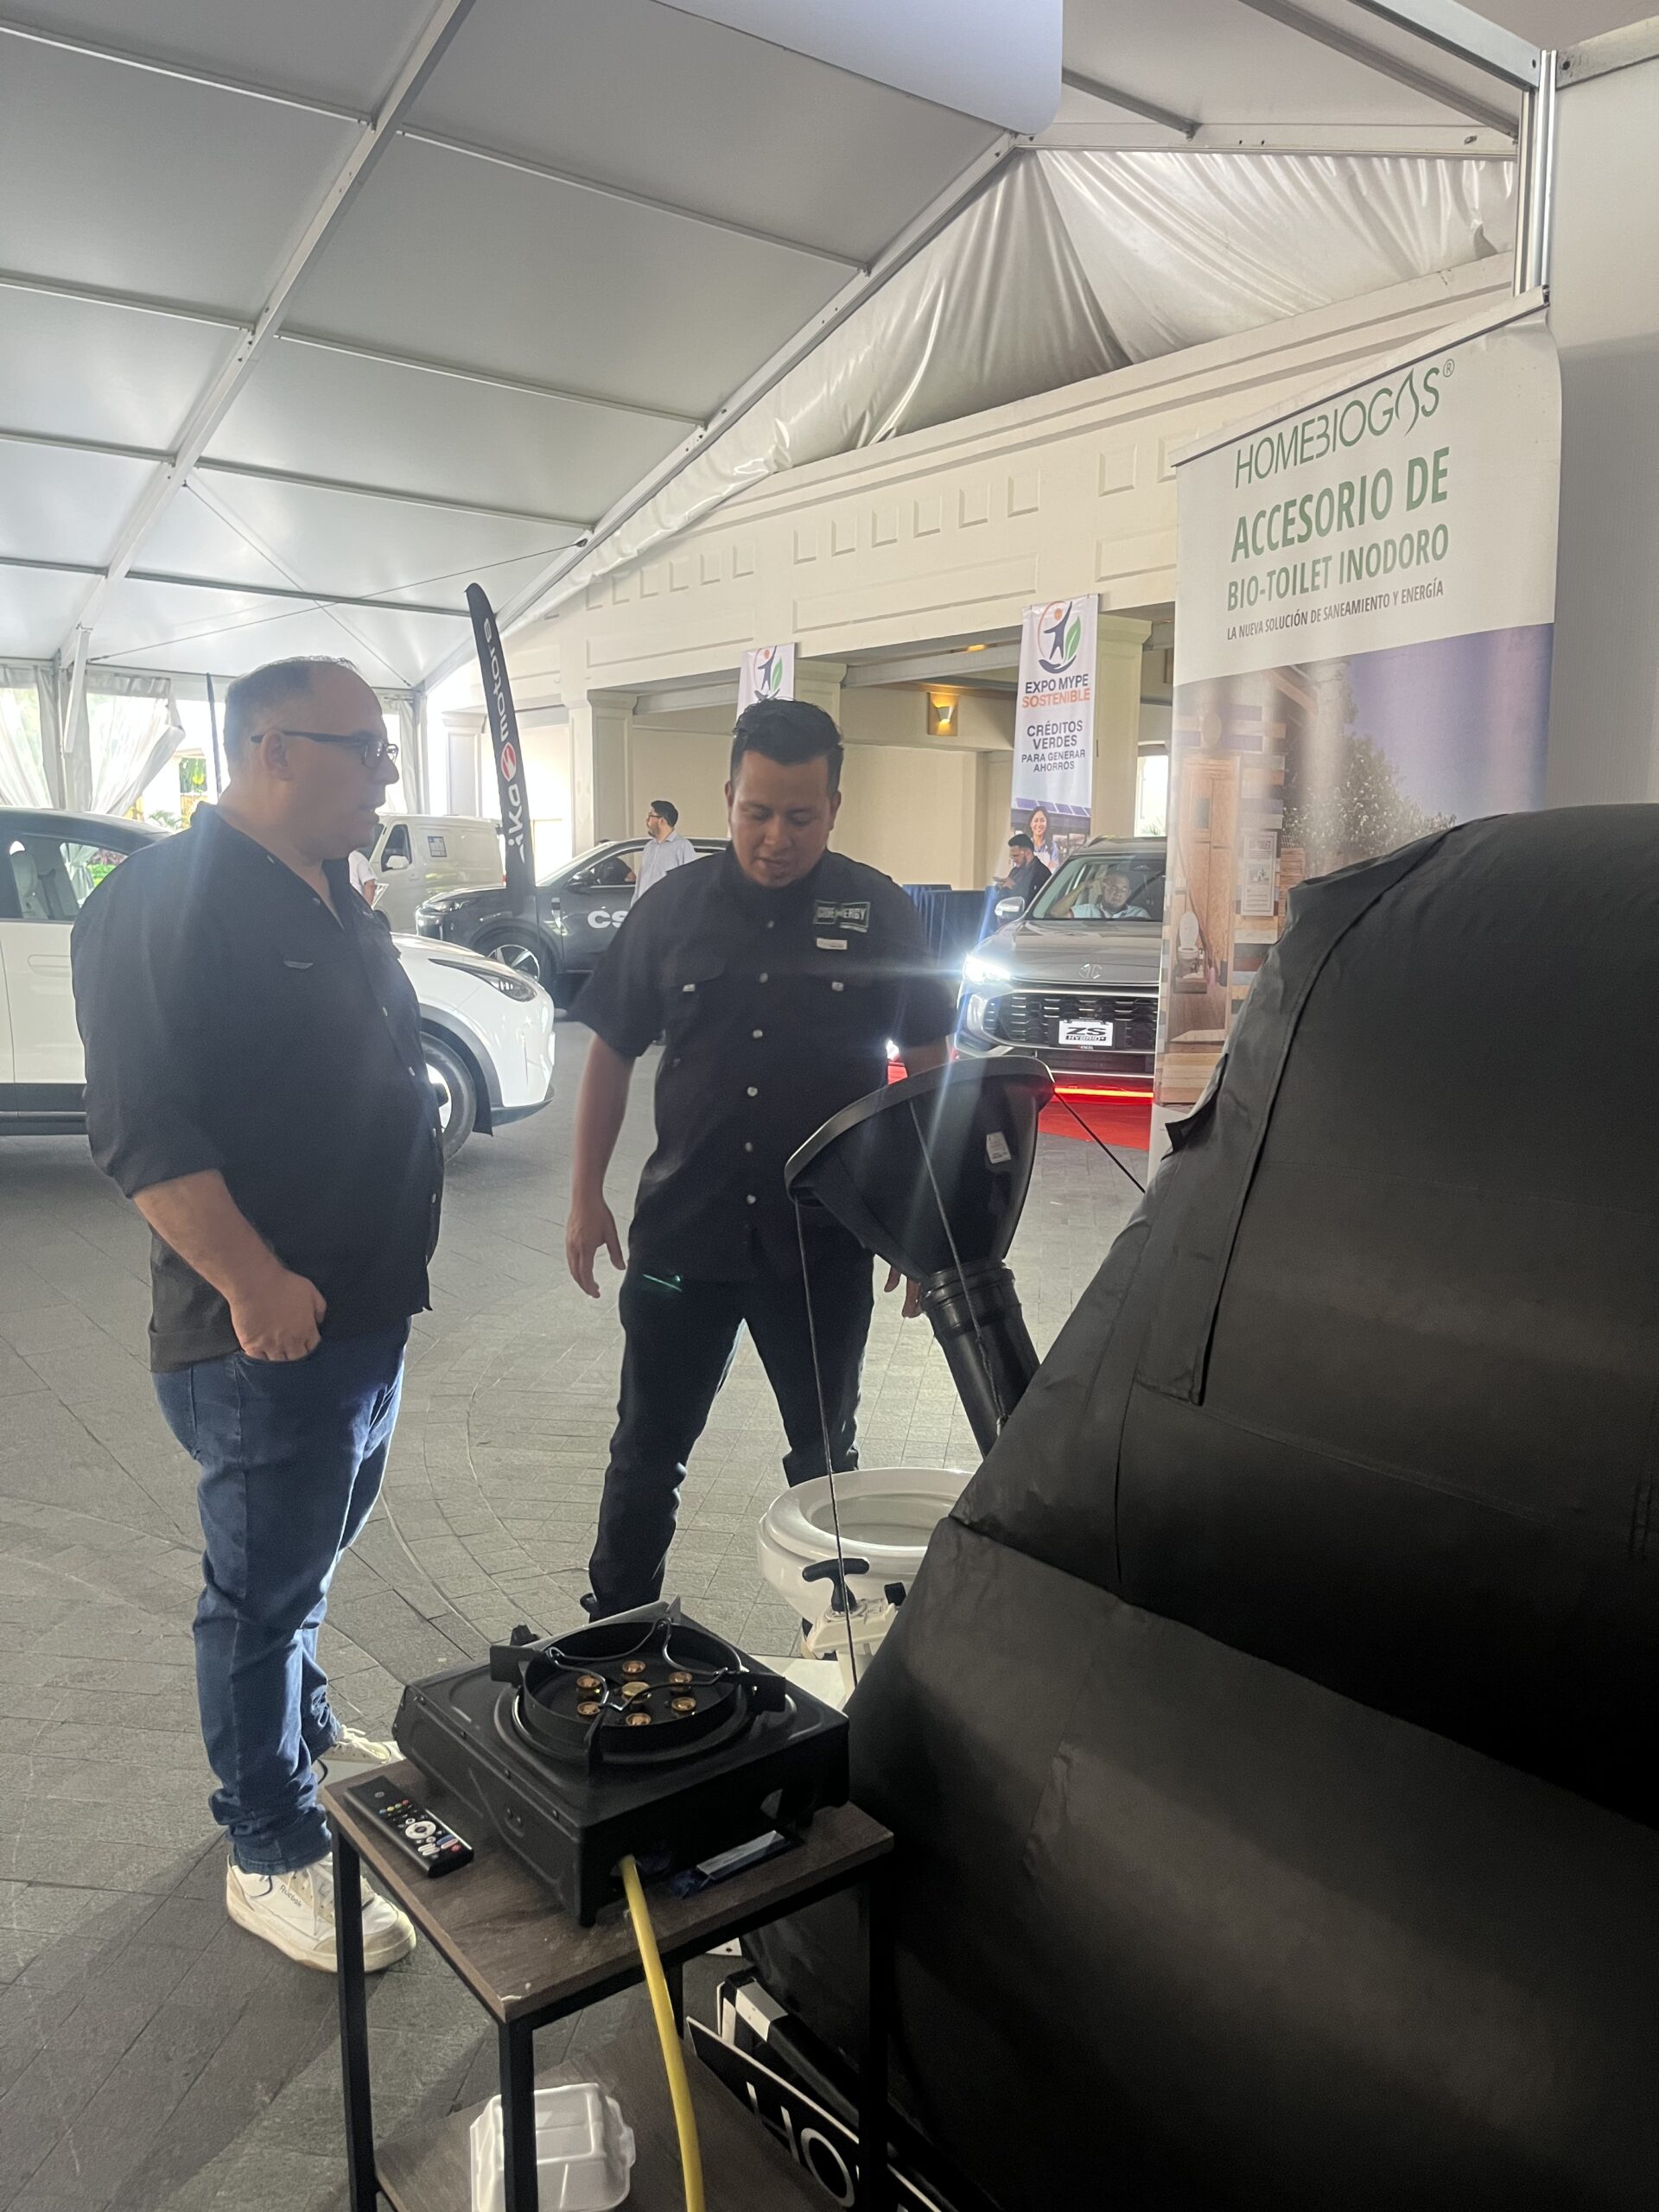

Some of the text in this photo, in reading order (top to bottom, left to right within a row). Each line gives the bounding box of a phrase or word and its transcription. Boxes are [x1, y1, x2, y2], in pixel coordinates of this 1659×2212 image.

[1231, 447, 1450, 563] ACCESORIO DE
[1227, 524, 1448, 611] BIO-TOILET INODORO
[1227, 577, 1444, 640] LA NUEVA SOLUCIÓN DE SANEAMIENTO Y ENERGÍA
[1025, 674, 1089, 694] EXPO MYPE
[1022, 687, 1090, 707] SOSTENIBLE
[1027, 720, 1083, 736] CRÉDITOS
[1033, 735, 1077, 750] VERDES
[1021, 749, 1085, 762] PARA GENERAR
[1033, 760, 1075, 772] AHORROS
